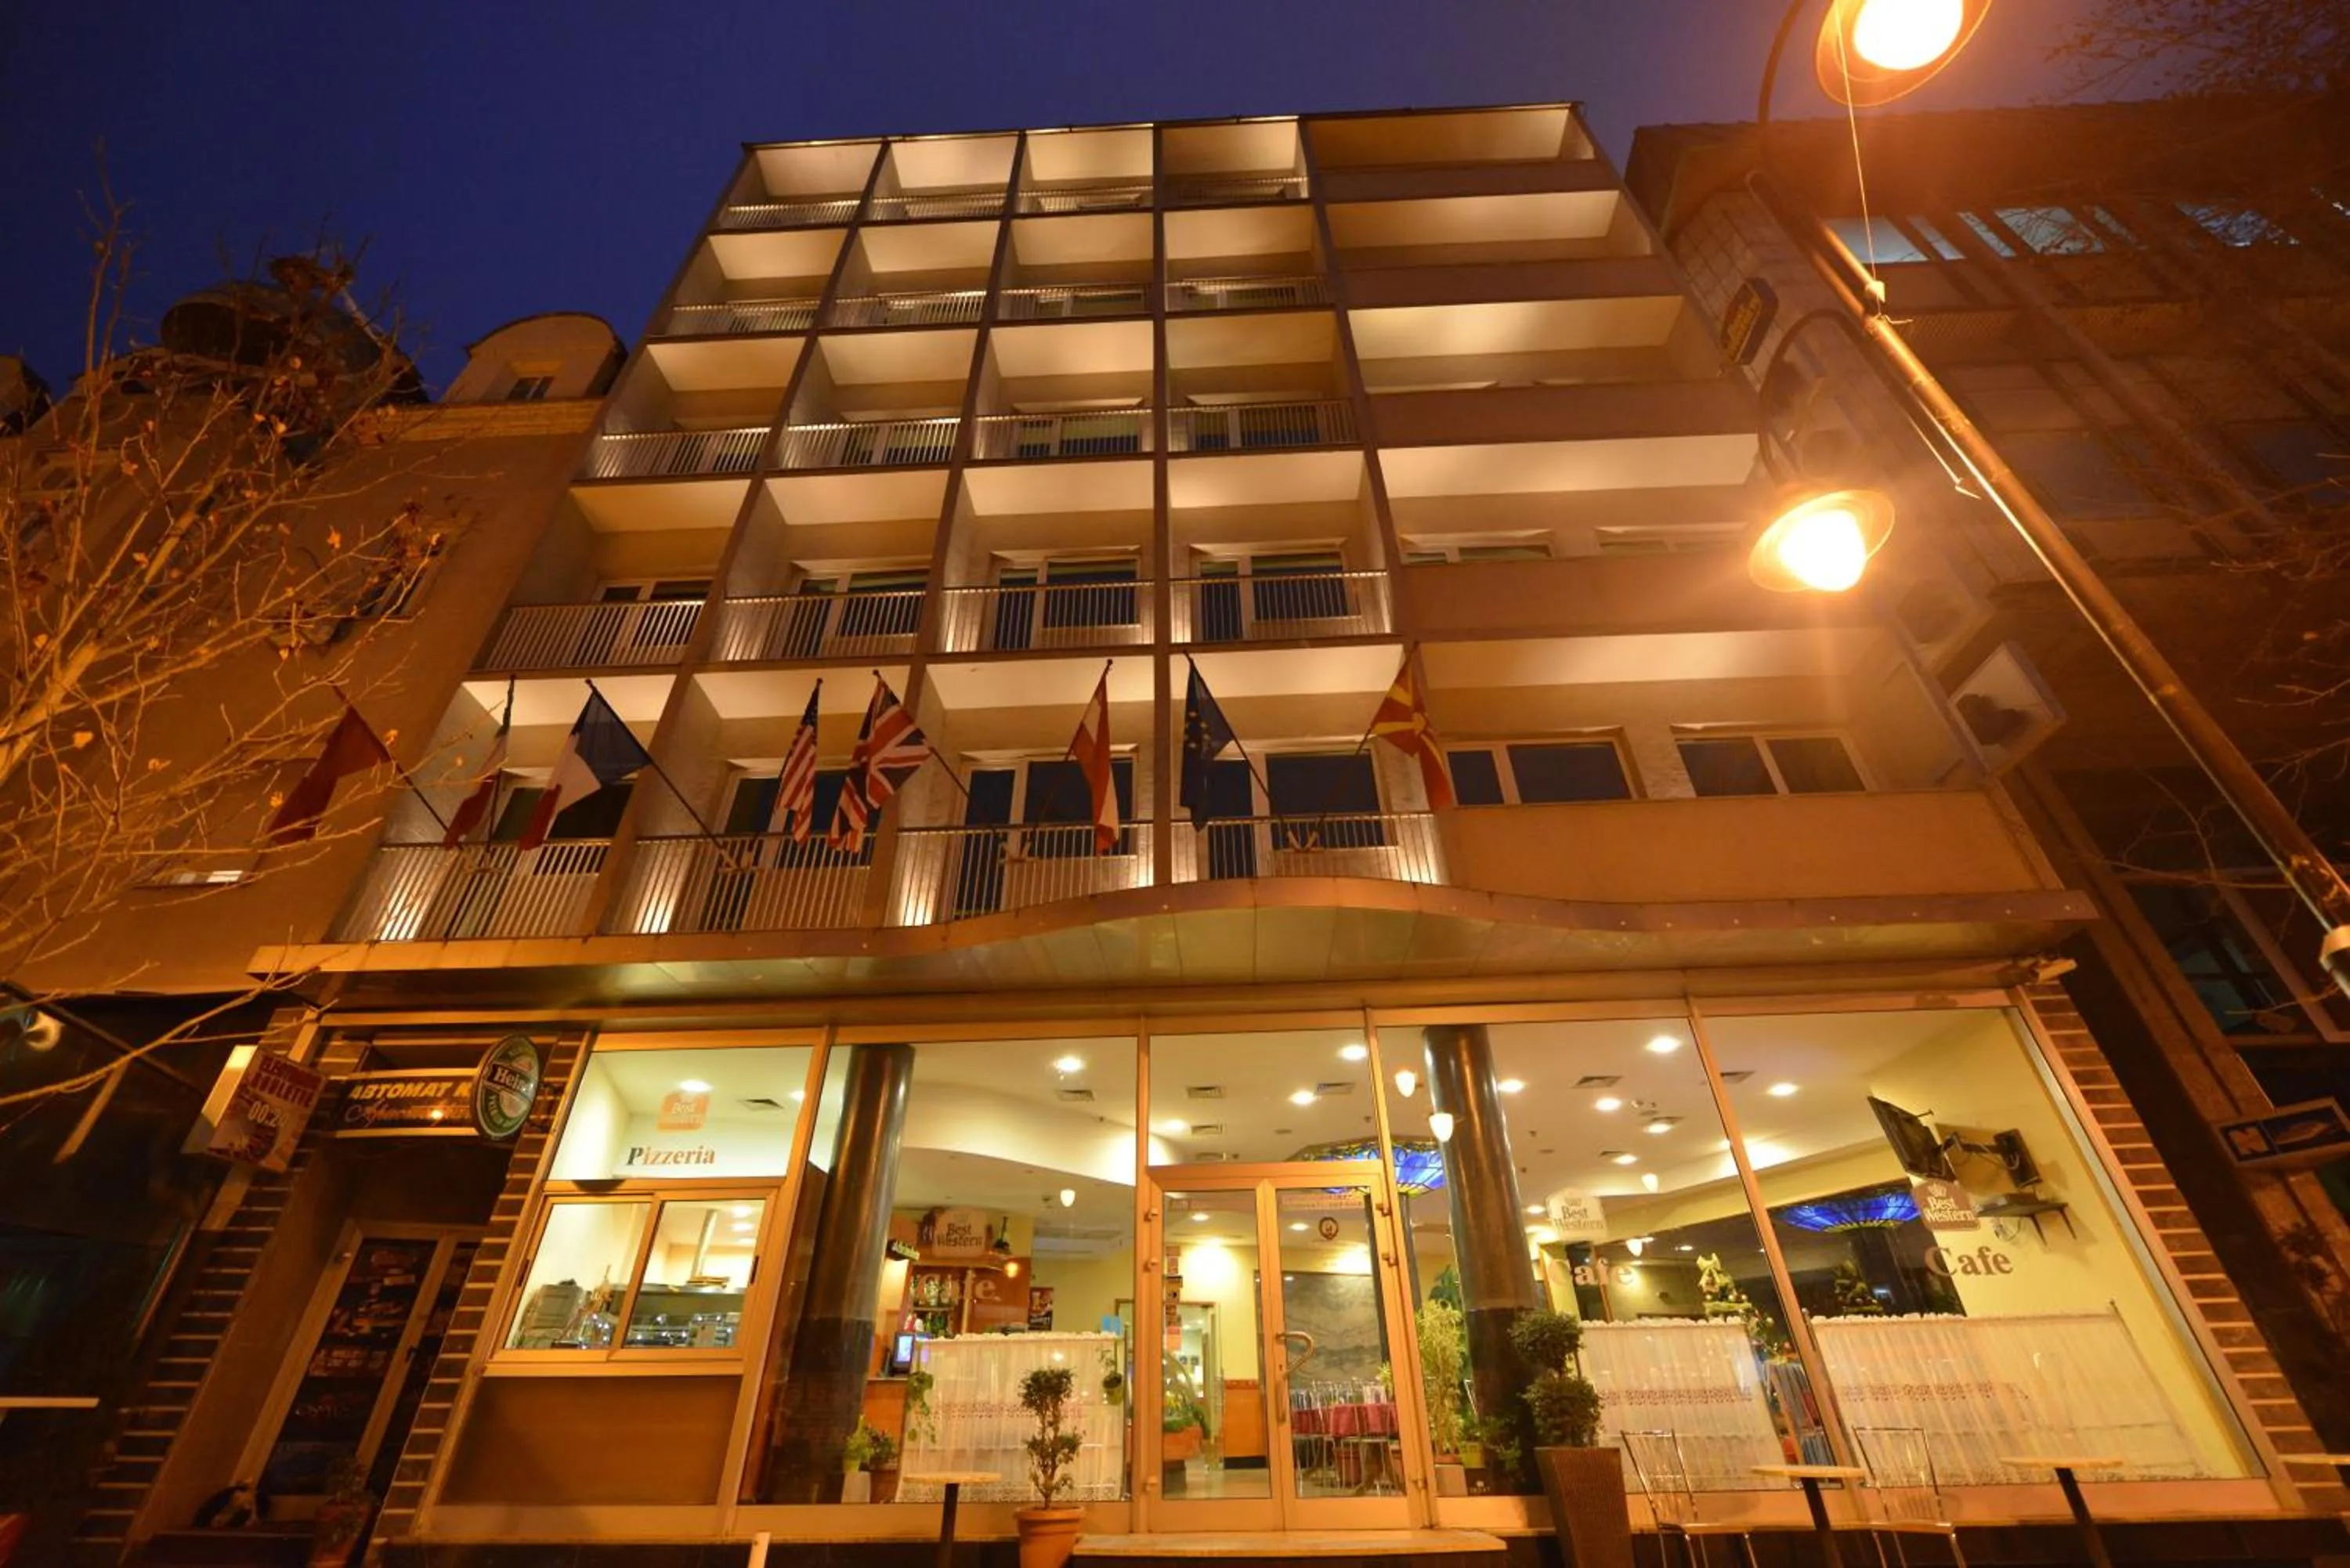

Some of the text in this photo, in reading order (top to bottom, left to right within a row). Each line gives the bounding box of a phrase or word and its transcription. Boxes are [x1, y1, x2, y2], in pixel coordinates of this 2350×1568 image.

[626, 1145, 715, 1165] Pizzeria
[1926, 1196, 1956, 1210] Best
[1561, 1205, 1589, 1219] Best
[1922, 1209, 1976, 1223] Western
[946, 1223, 972, 1236] Best
[1553, 1218, 1604, 1230] Western
[936, 1234, 985, 1247] Western
[1925, 1245, 2014, 1277] Cafe
